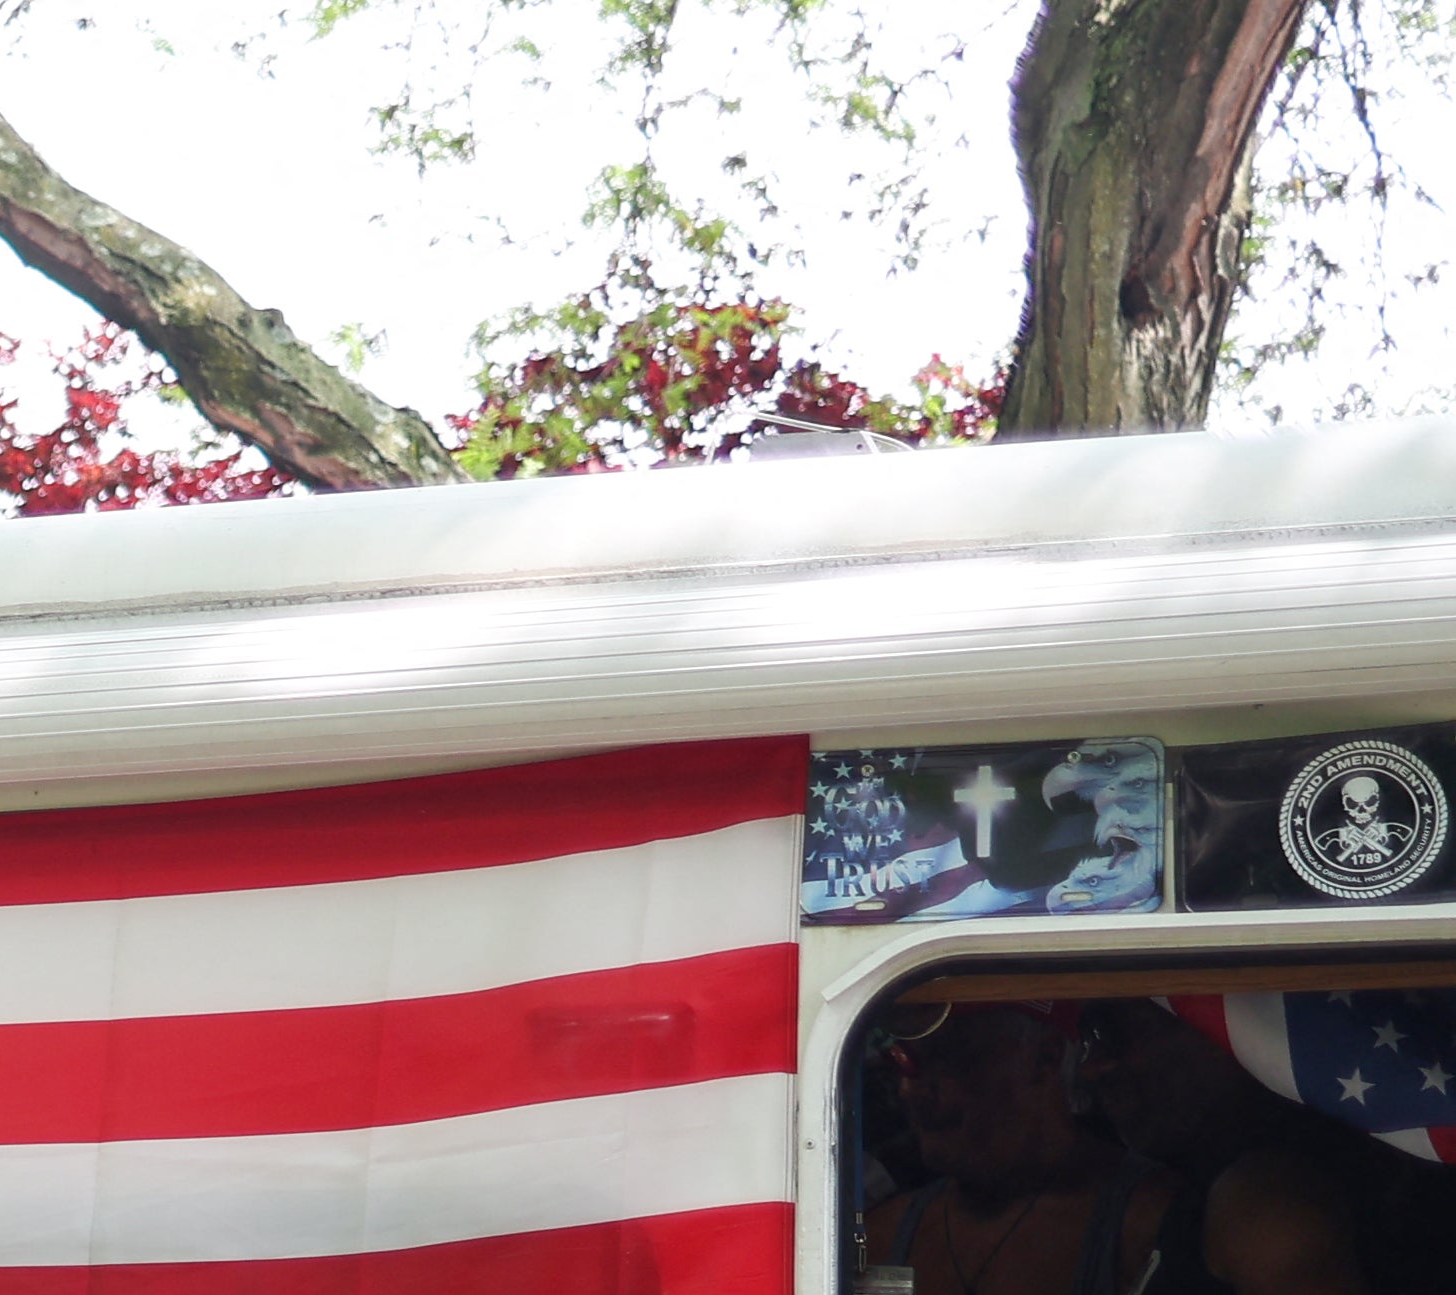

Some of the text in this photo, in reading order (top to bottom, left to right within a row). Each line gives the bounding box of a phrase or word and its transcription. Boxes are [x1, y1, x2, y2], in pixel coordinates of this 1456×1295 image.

[1298, 755, 1428, 808] 2ND AMENDMENT
[1350, 853, 1381, 865] 1789
